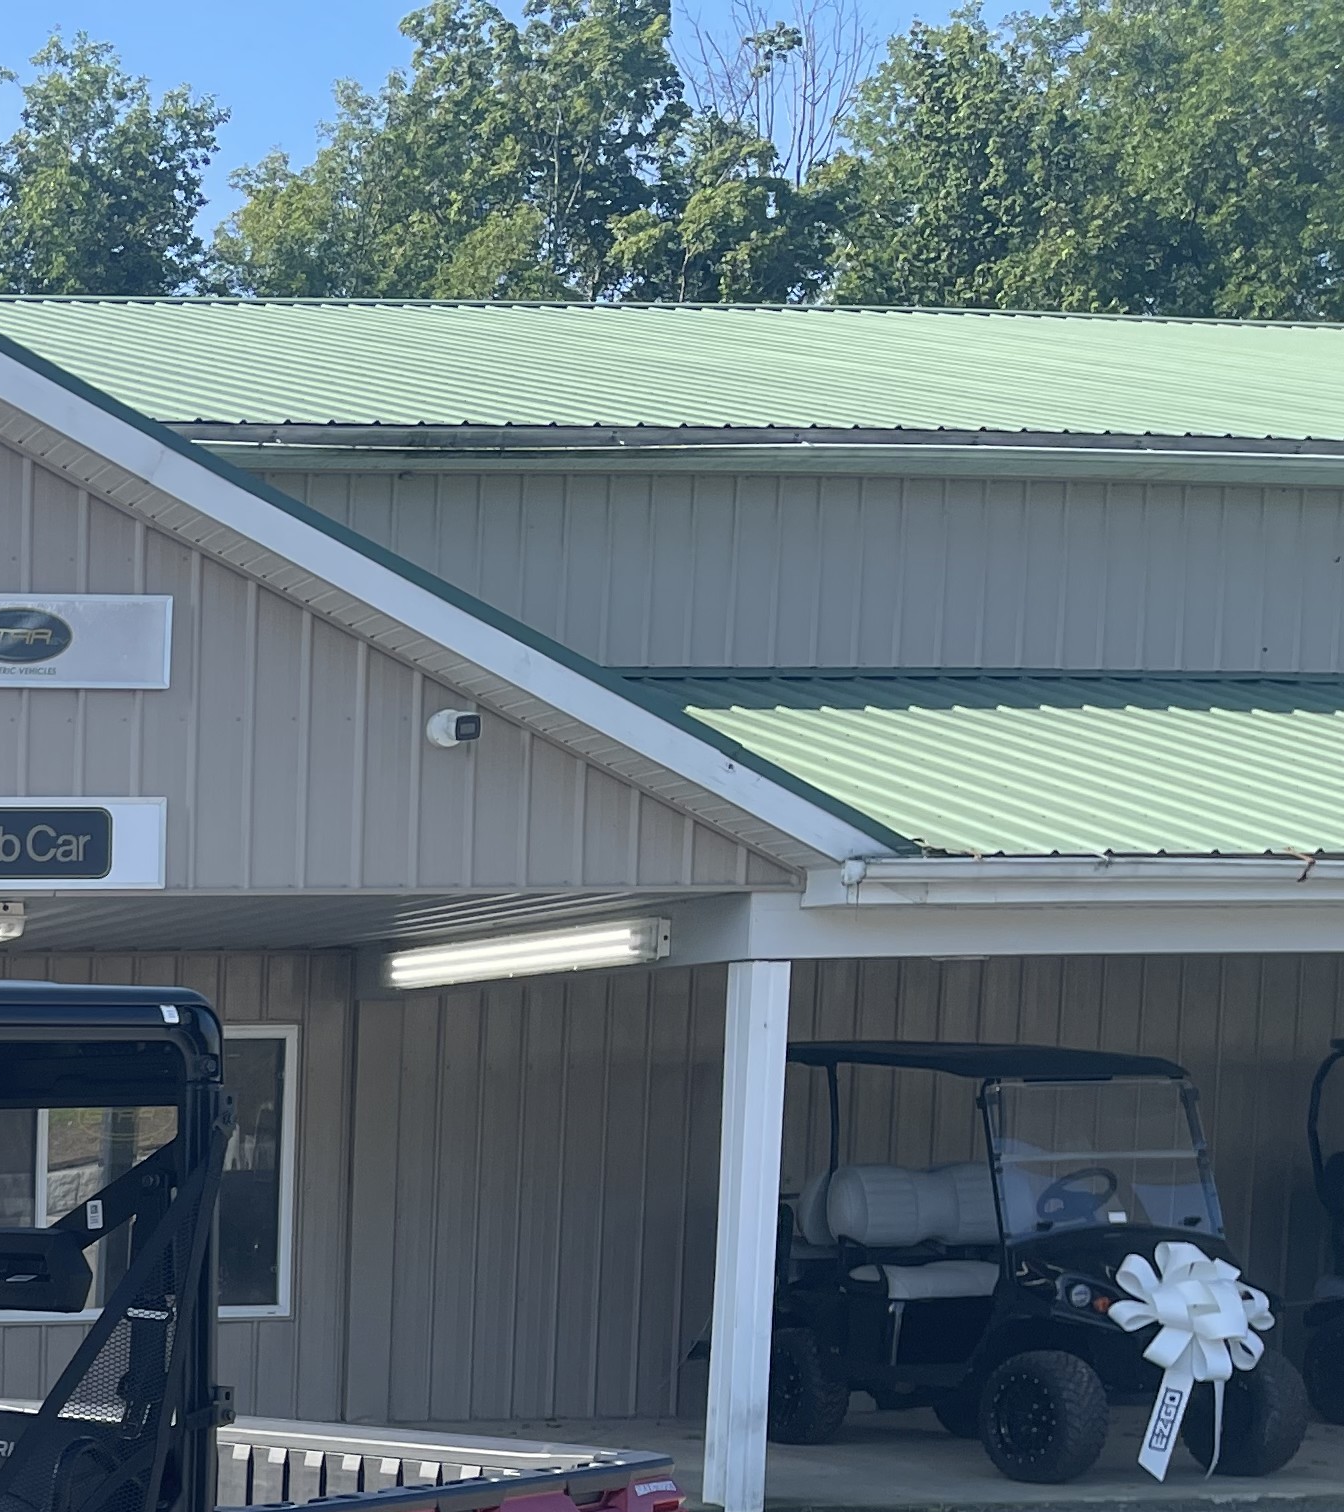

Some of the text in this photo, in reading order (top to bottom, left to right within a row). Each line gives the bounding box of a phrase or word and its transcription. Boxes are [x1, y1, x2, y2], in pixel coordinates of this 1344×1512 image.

[19, 667, 57, 675] VEHICLES
[26, 824, 91, 862] Car
[1150, 1390, 1181, 1450] EZGO
